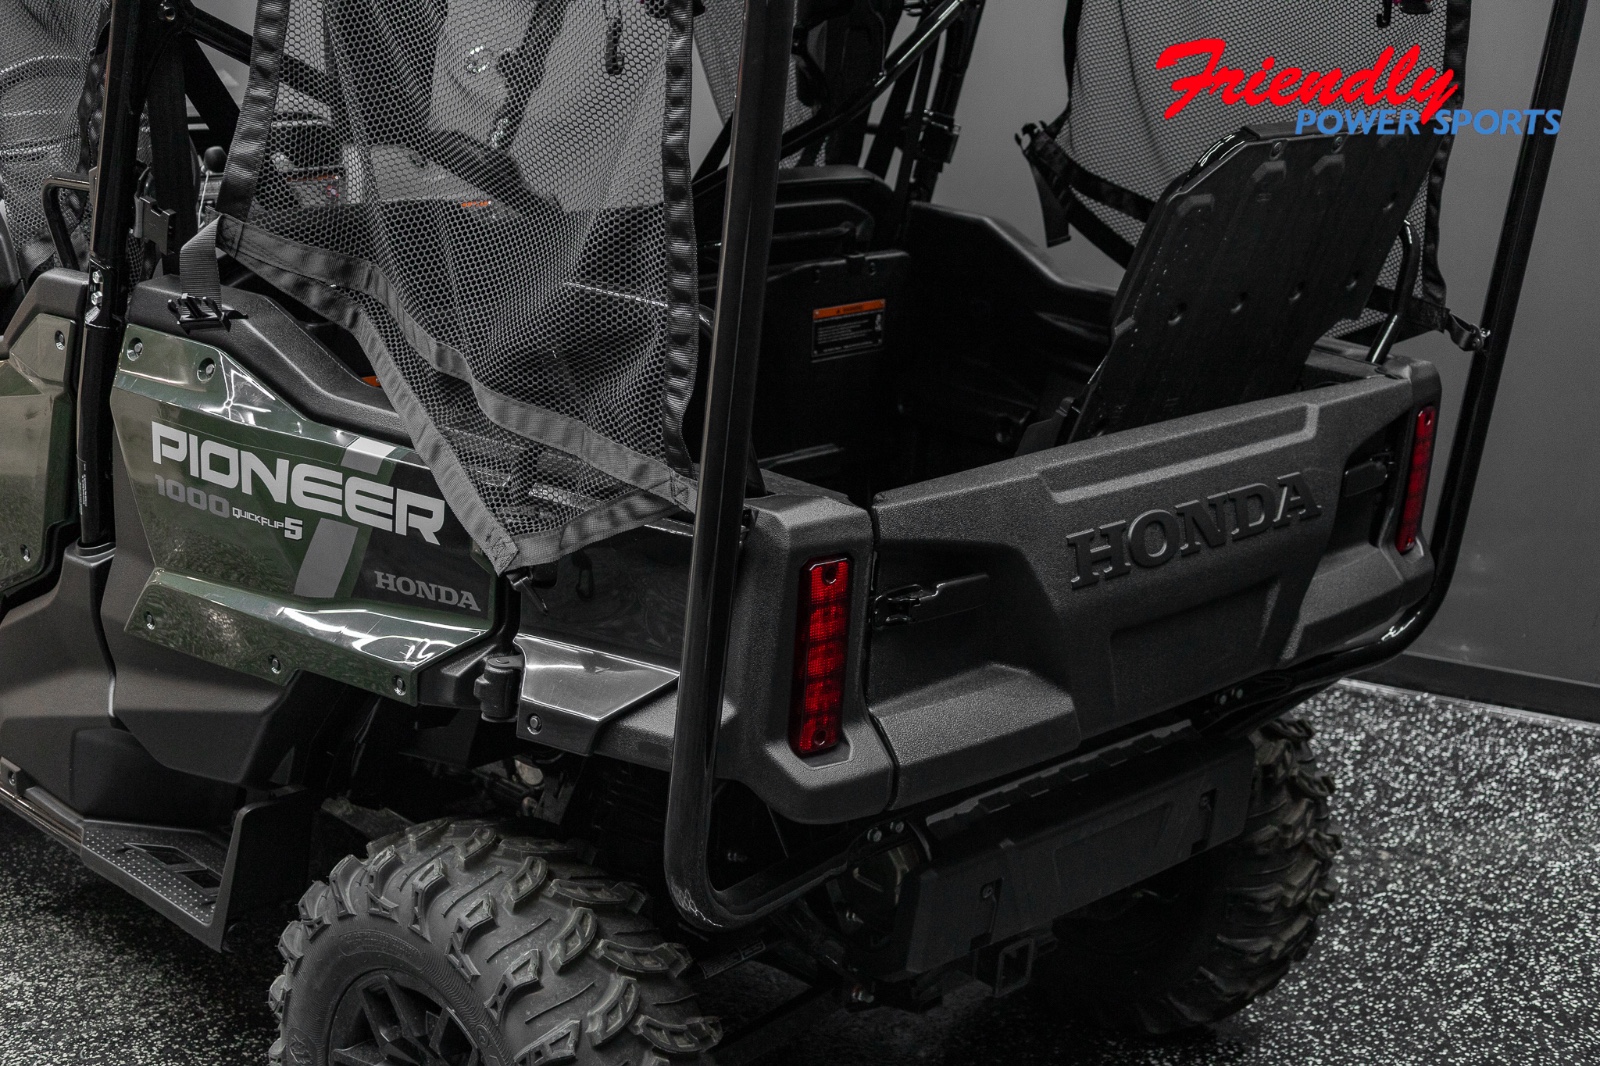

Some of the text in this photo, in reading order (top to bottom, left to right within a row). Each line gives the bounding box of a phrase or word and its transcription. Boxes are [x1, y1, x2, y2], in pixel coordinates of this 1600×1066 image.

[151, 421, 445, 546] PIONEER
[154, 474, 230, 519] 1000
[1066, 472, 1322, 590] HONDA
[373, 570, 481, 612] HONDA
